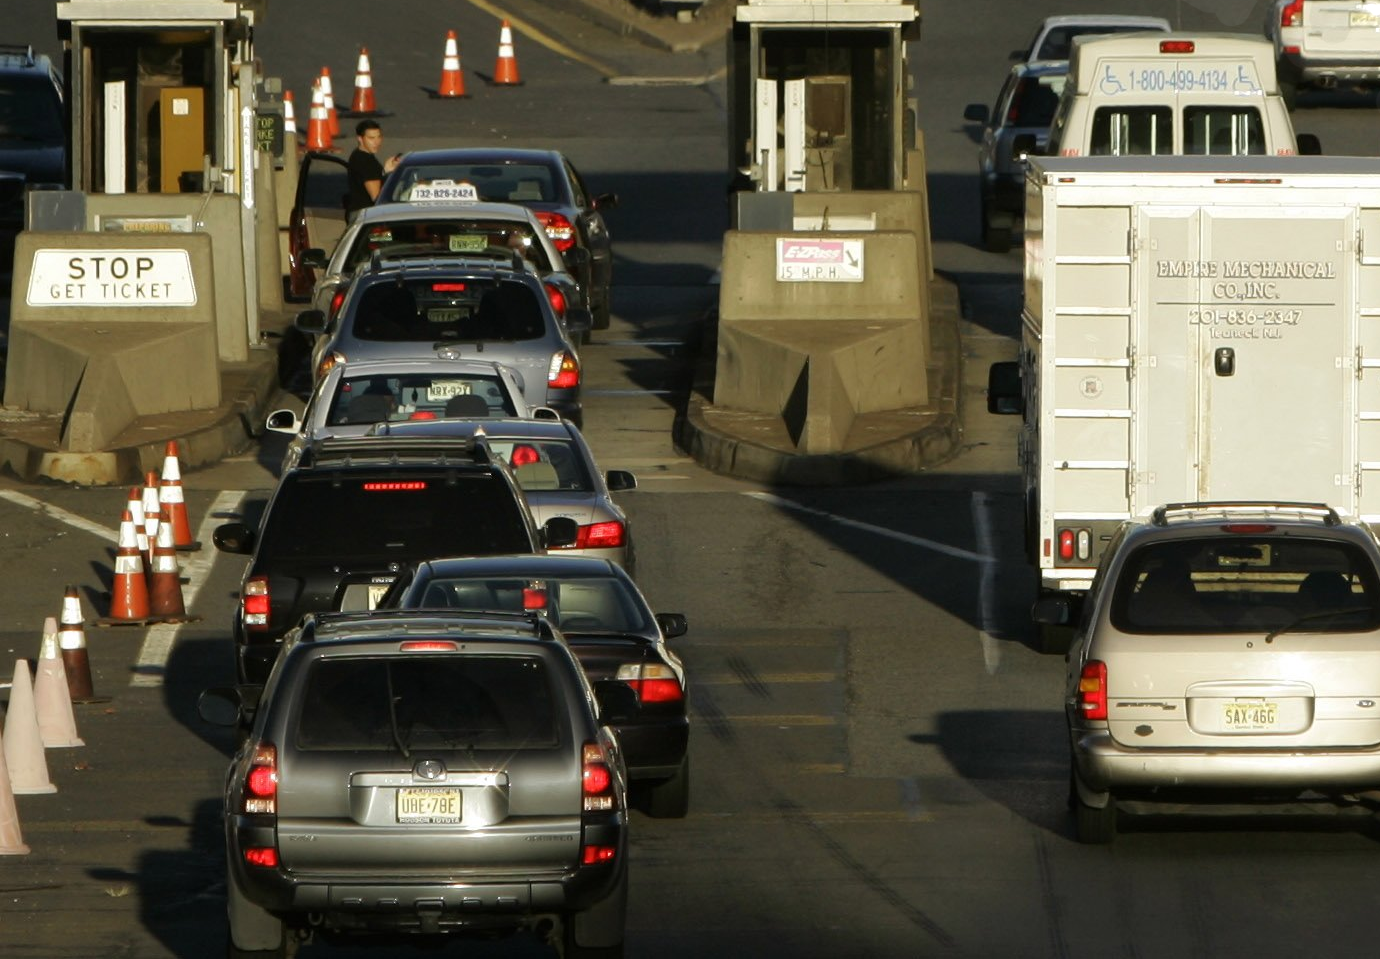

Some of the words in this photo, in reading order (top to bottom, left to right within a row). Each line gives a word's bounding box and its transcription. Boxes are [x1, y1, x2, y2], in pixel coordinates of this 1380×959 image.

[1129, 70, 1228, 91] 1-800-499-4134
[69, 258, 154, 279] STOP
[1157, 260, 1217, 278] EMPIRE
[1223, 260, 1336, 279] MECHANICAL
[50, 284, 85, 298] GET
[102, 283, 172, 298] TICKET
[1189, 309, 1302, 326] 201-836-2347
